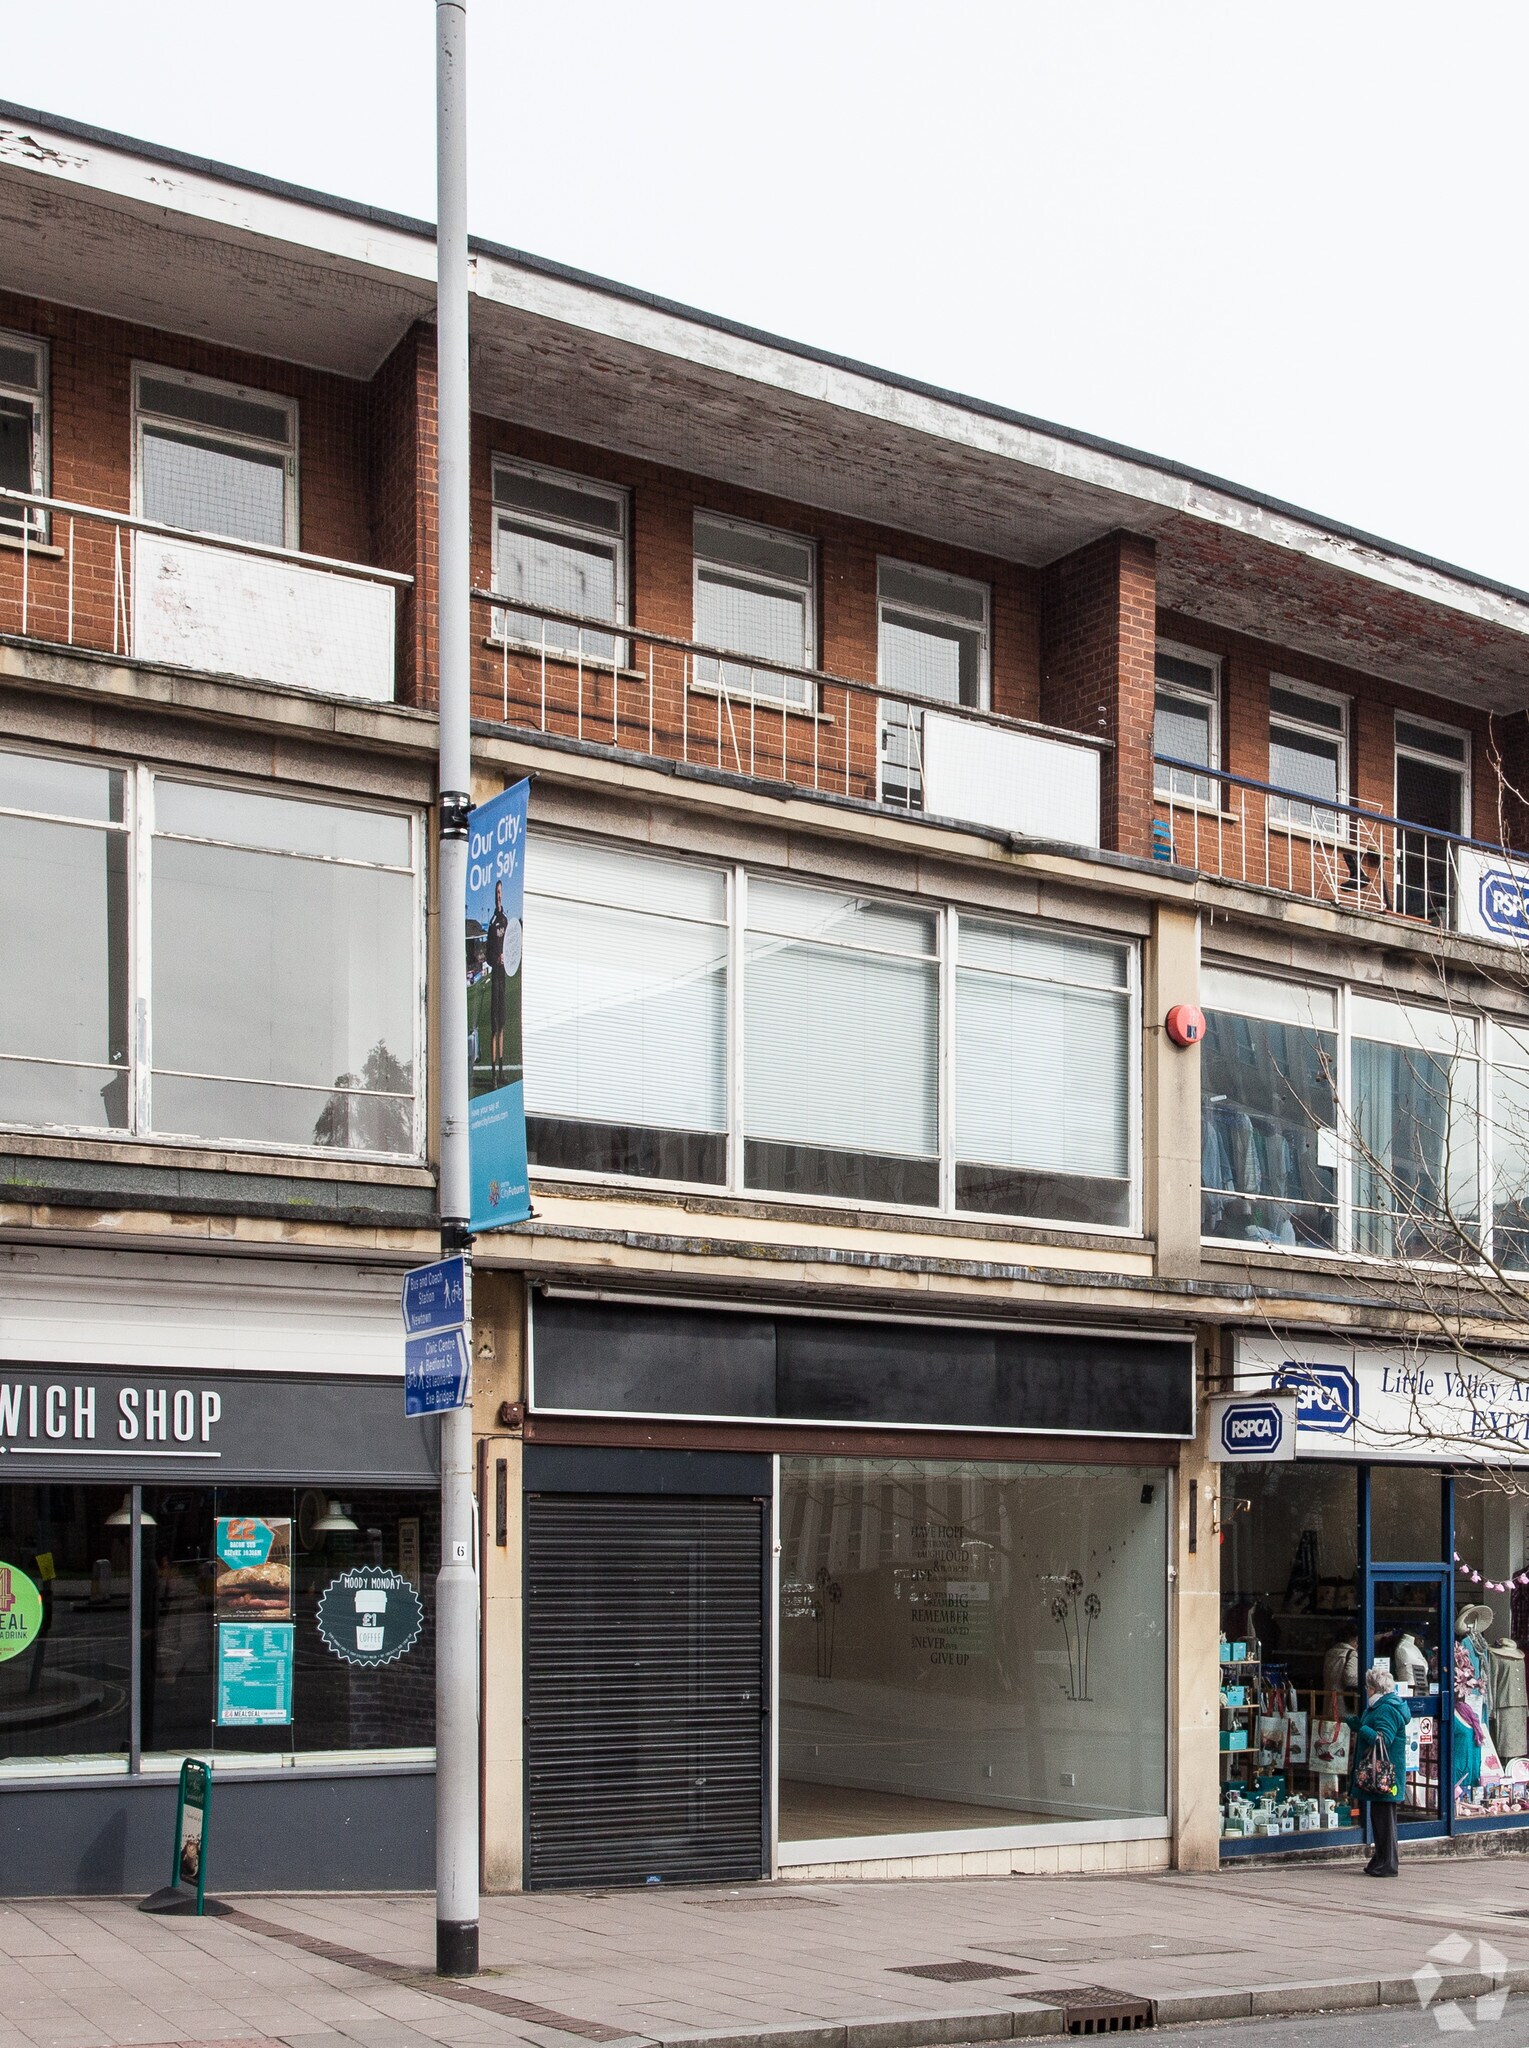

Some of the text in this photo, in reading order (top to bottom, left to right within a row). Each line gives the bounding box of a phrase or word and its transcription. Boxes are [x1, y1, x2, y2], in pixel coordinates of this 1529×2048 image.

[471, 814, 522, 859] Our City.
[470, 849, 518, 891] Our Say.
[410, 1270, 443, 1290] Bus and Coach
[418, 1290, 435, 1305] Station
[411, 1313, 431, 1327] Newtown
[425, 1339, 456, 1355] Civic Centre
[425, 1354, 453, 1372] Bedford St
[425, 1375, 432, 1389] St
[1381, 1367, 1434, 1396] Little
[1444, 1372, 1501, 1402] Valley
[425, 1390, 455, 1405] Exe Bridges
[118, 1387, 222, 1442] SHOP
[1231, 1419, 1272, 1439] RSPCA
[227, 1519, 256, 1541] £2
[911, 1526, 965, 1538] HAVE HOPE
[457, 1545, 465, 1557] 6
[940, 1550, 970, 1562] LOUD
[911, 1568, 932, 1582] LIVE
[344, 1577, 401, 1590] MOODY MONDAY
[948, 1593, 969, 1608] BIG
[362, 1613, 377, 1627] £1
[911, 1609, 970, 1624] REMEMBER
[5, 1631, 28, 1640] DRINK
[359, 1632, 381, 1643] COFFEE
[946, 1626, 969, 1635] LOVED
[915, 1636, 946, 1649] NEVER
[930, 1652, 970, 1666] GIVE UP
